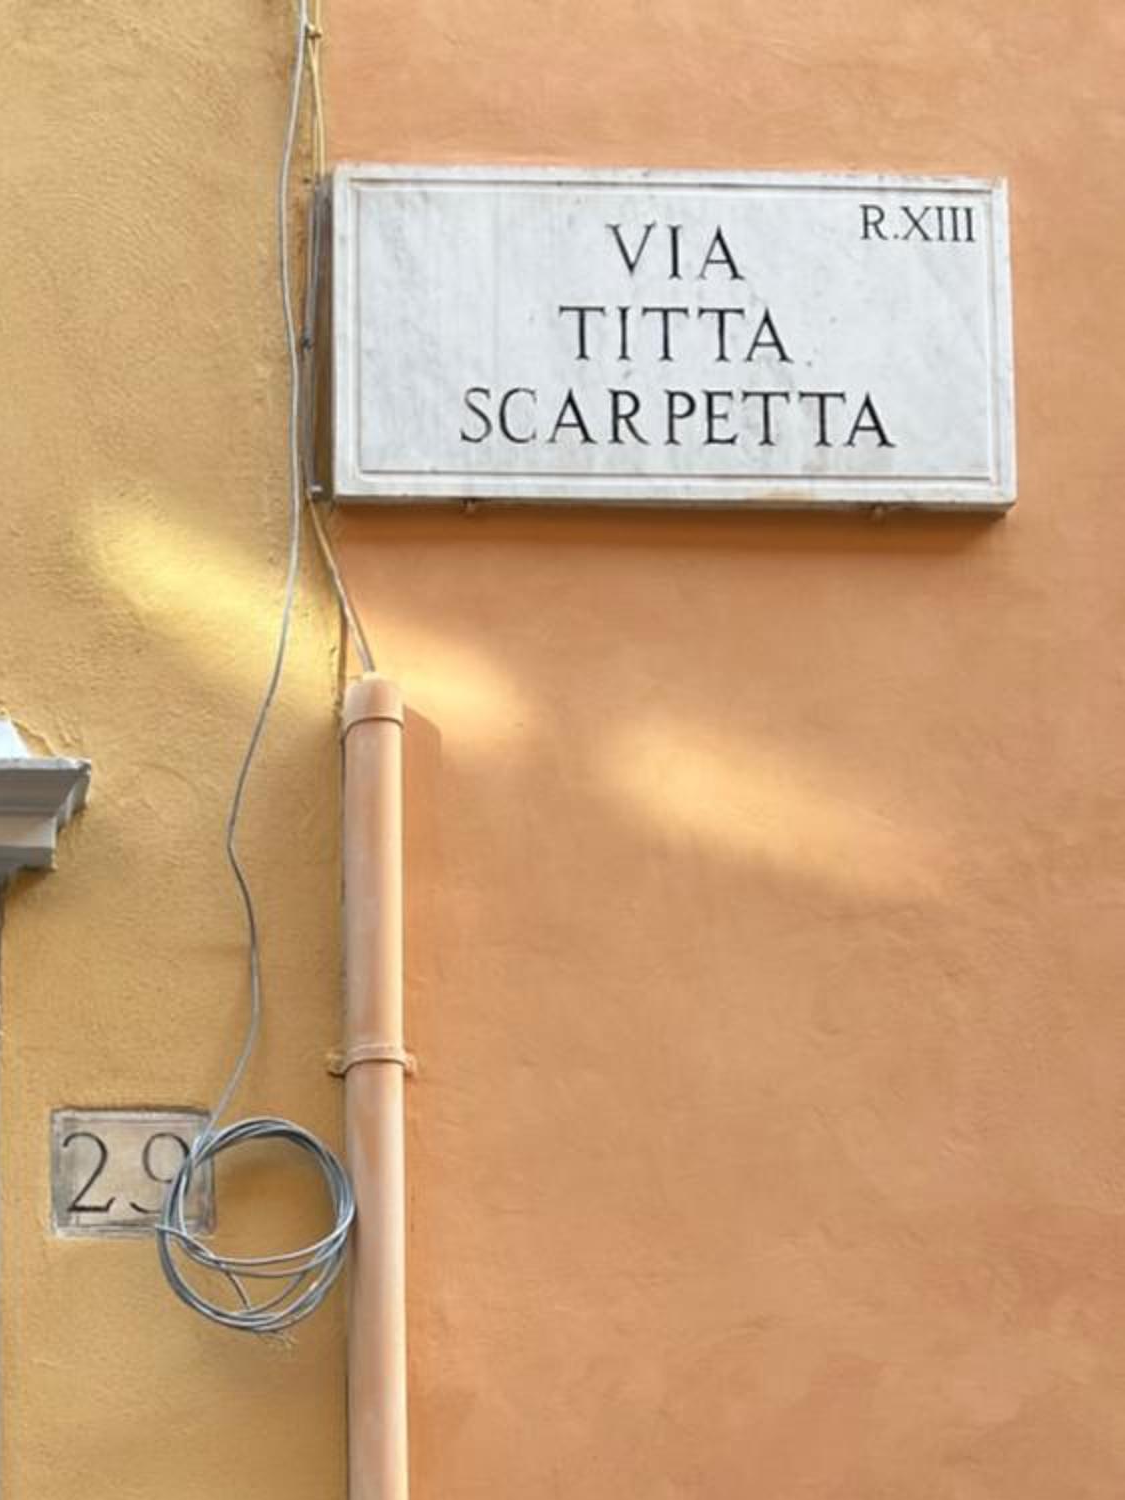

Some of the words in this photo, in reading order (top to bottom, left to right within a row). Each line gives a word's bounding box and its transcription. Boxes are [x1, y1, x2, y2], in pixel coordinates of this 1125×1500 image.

[605, 221, 746, 281] VIA
[859, 203, 976, 243] R.XIII
[557, 305, 794, 365] TITTA
[459, 386, 897, 449] SCARPETTA
[62, 1131, 193, 1215] 29
